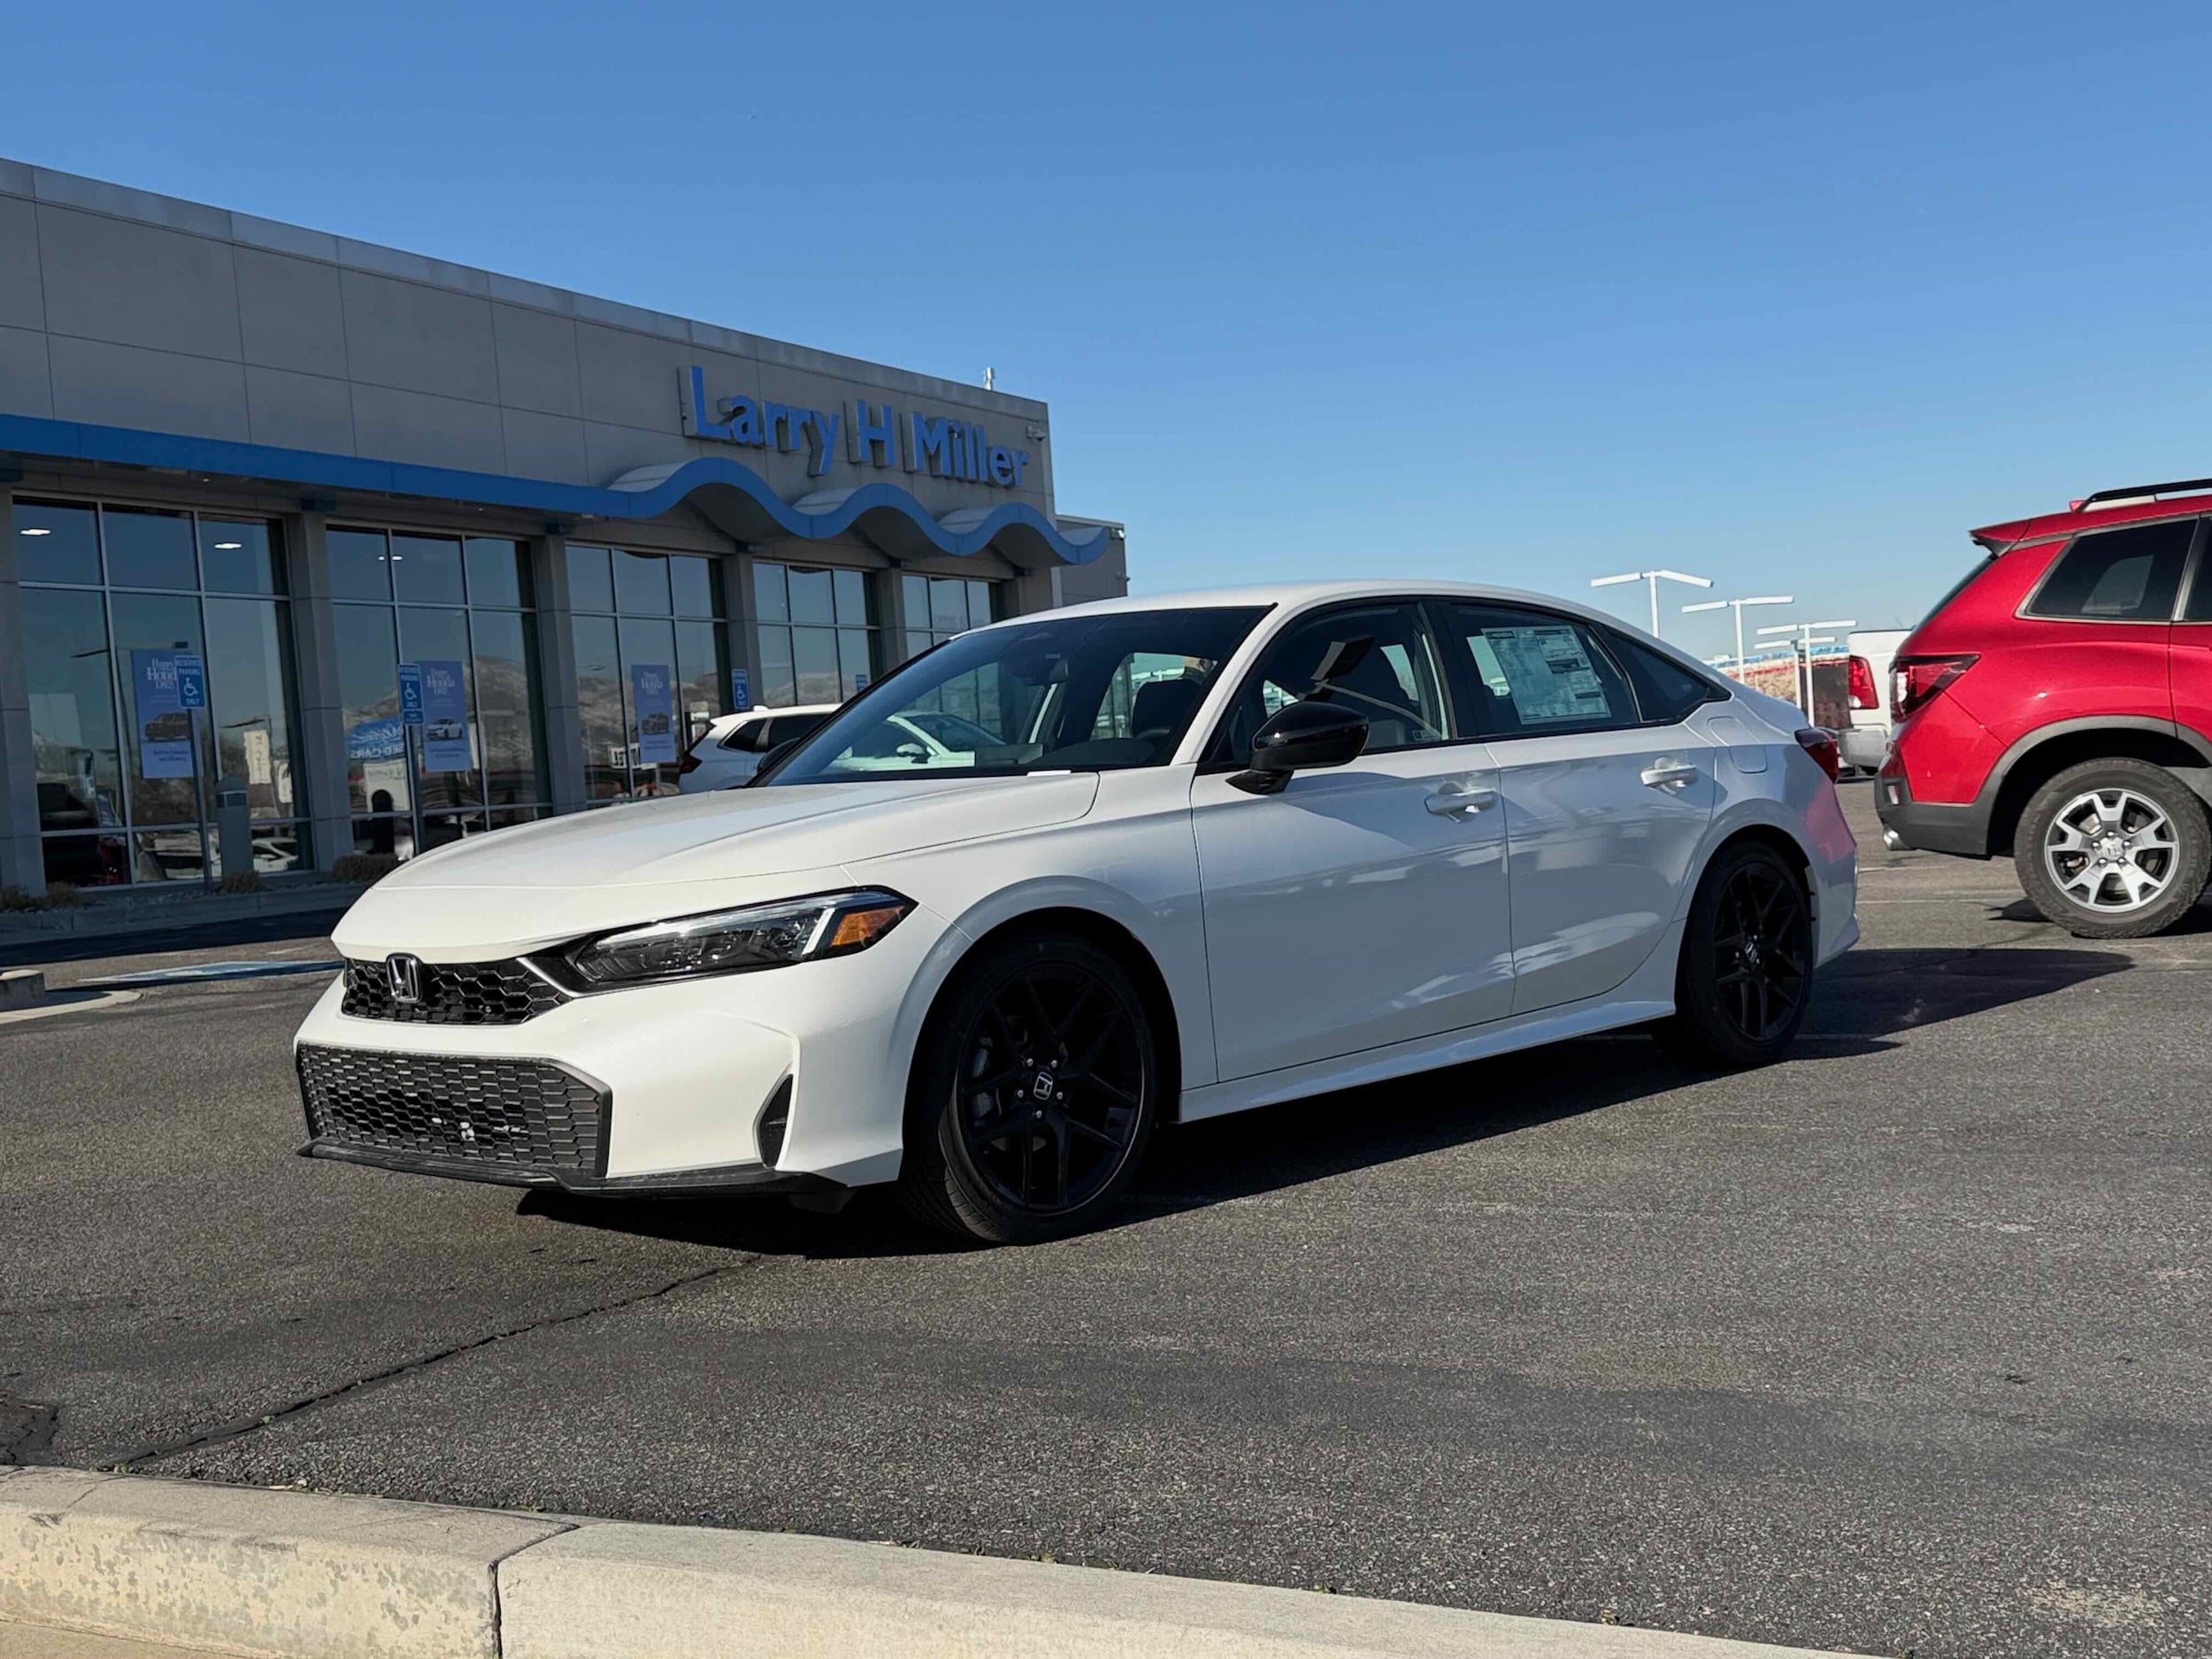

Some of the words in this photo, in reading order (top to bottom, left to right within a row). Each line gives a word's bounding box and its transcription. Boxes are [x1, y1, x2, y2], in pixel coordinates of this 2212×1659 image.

[687, 365, 841, 476] Larry
[855, 399, 895, 467] H
[911, 411, 1031, 486] Miller
[146, 667, 177, 680] Hond
